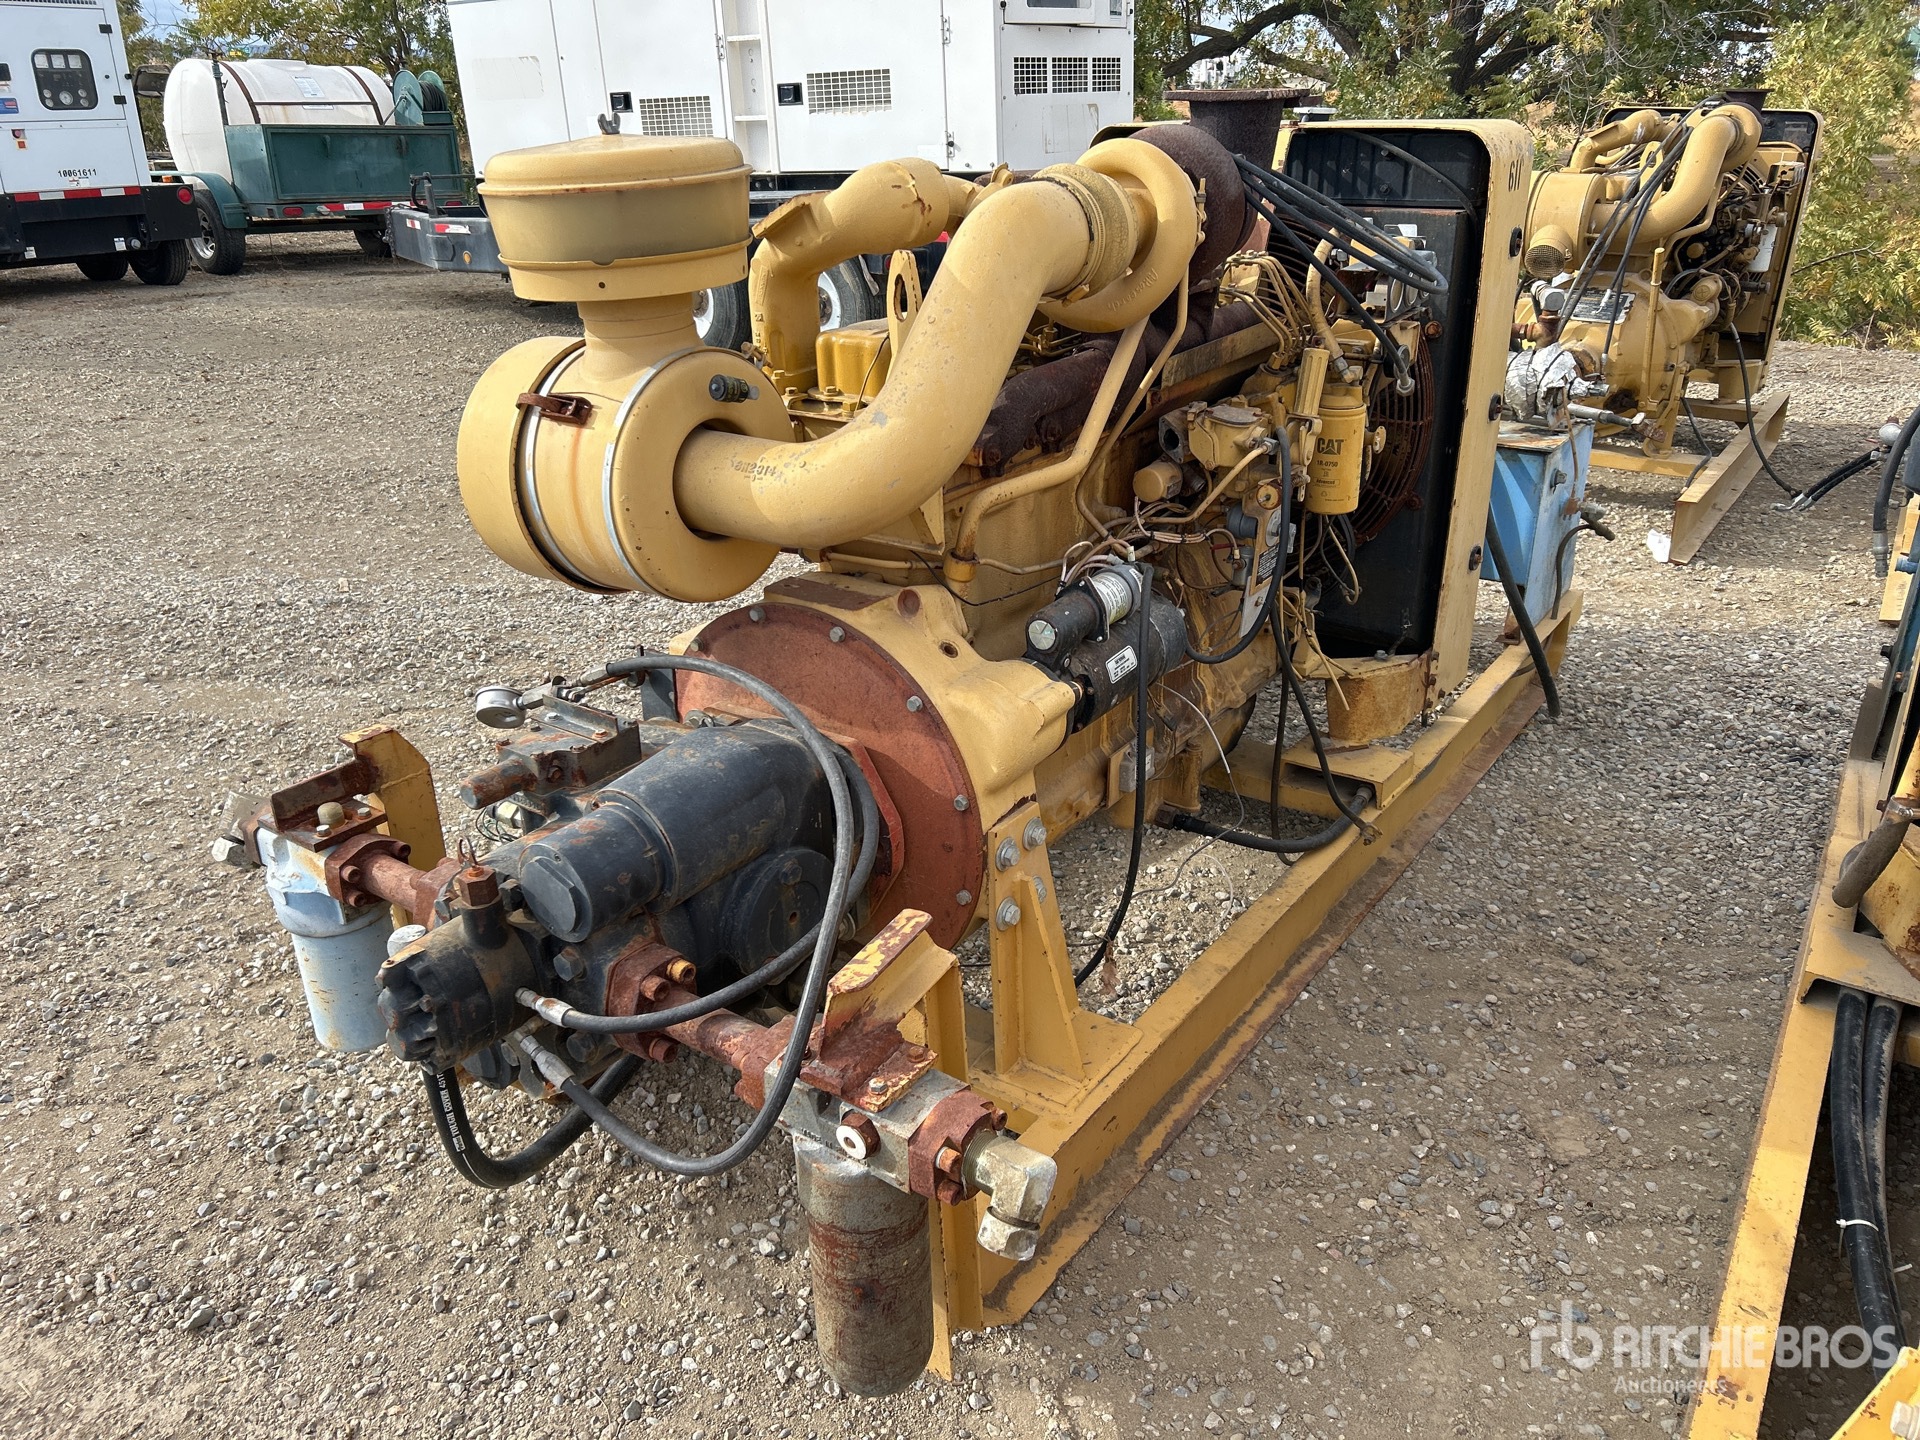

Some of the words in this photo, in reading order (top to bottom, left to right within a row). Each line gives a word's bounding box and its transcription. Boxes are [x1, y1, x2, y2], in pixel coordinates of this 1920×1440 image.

[58, 169, 97, 178] 10061611
[1317, 437, 1345, 455] CAT
[1316, 460, 1339, 468] 1R-0750
[440, 1089, 454, 1113] COVER
[445, 1112, 460, 1137] TOUGH
